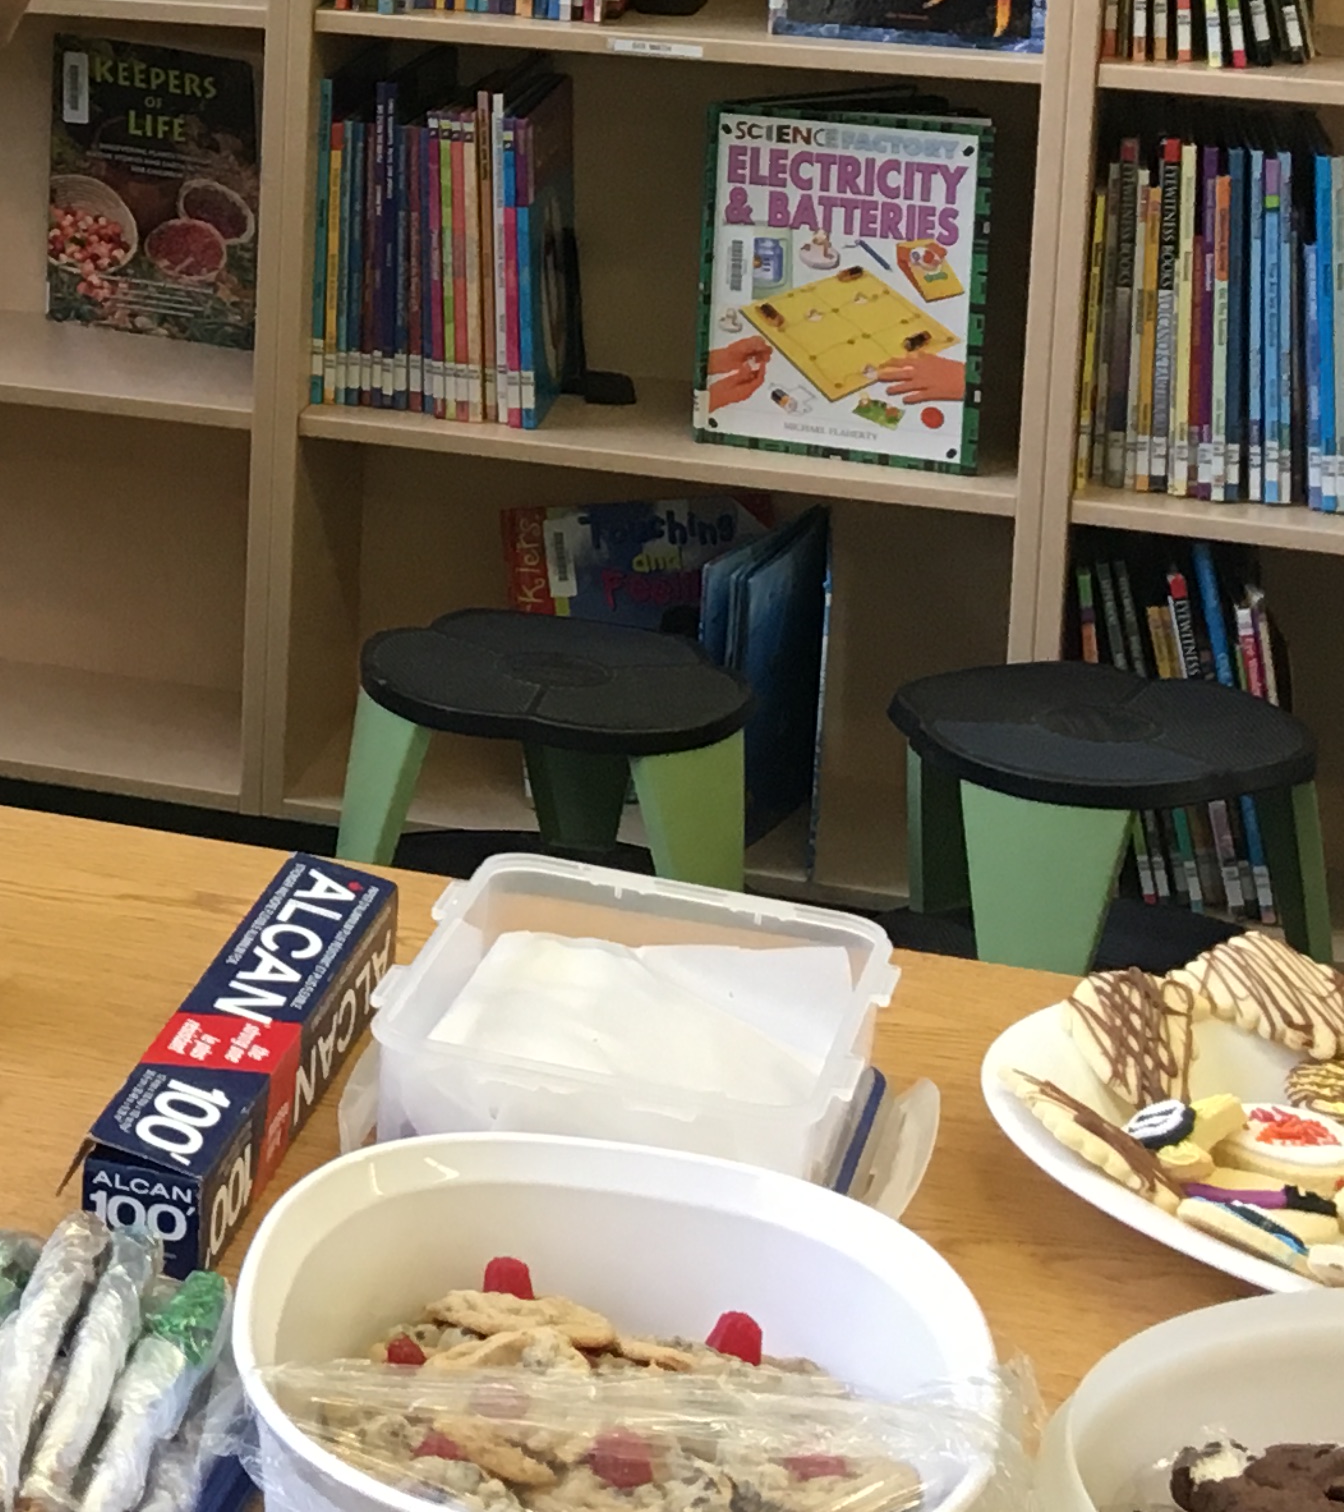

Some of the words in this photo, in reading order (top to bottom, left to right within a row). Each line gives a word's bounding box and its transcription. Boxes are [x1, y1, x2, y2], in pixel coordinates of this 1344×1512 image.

[92, 57, 218, 100] KEEPERS
[127, 110, 187, 143] LIFE
[733, 120, 840, 149] SCIENCE
[840, 130, 960, 160] FACTORY
[727, 144, 968, 206] ELECTRICITY
[1161, 165, 1177, 242] EYEWITNESS
[724, 186, 755, 226] &
[768, 189, 959, 247] BATTERIES
[1160, 244, 1175, 288] BOOKS
[1174, 599, 1201, 676] EYEWITNESS
[212, 867, 357, 1025] ALCAN
[292, 928, 393, 1127] ALCAN
[134, 1078, 231, 1167] 100'
[89, 1189, 197, 1243] 100'
[91, 1168, 194, 1204] ALCAN
